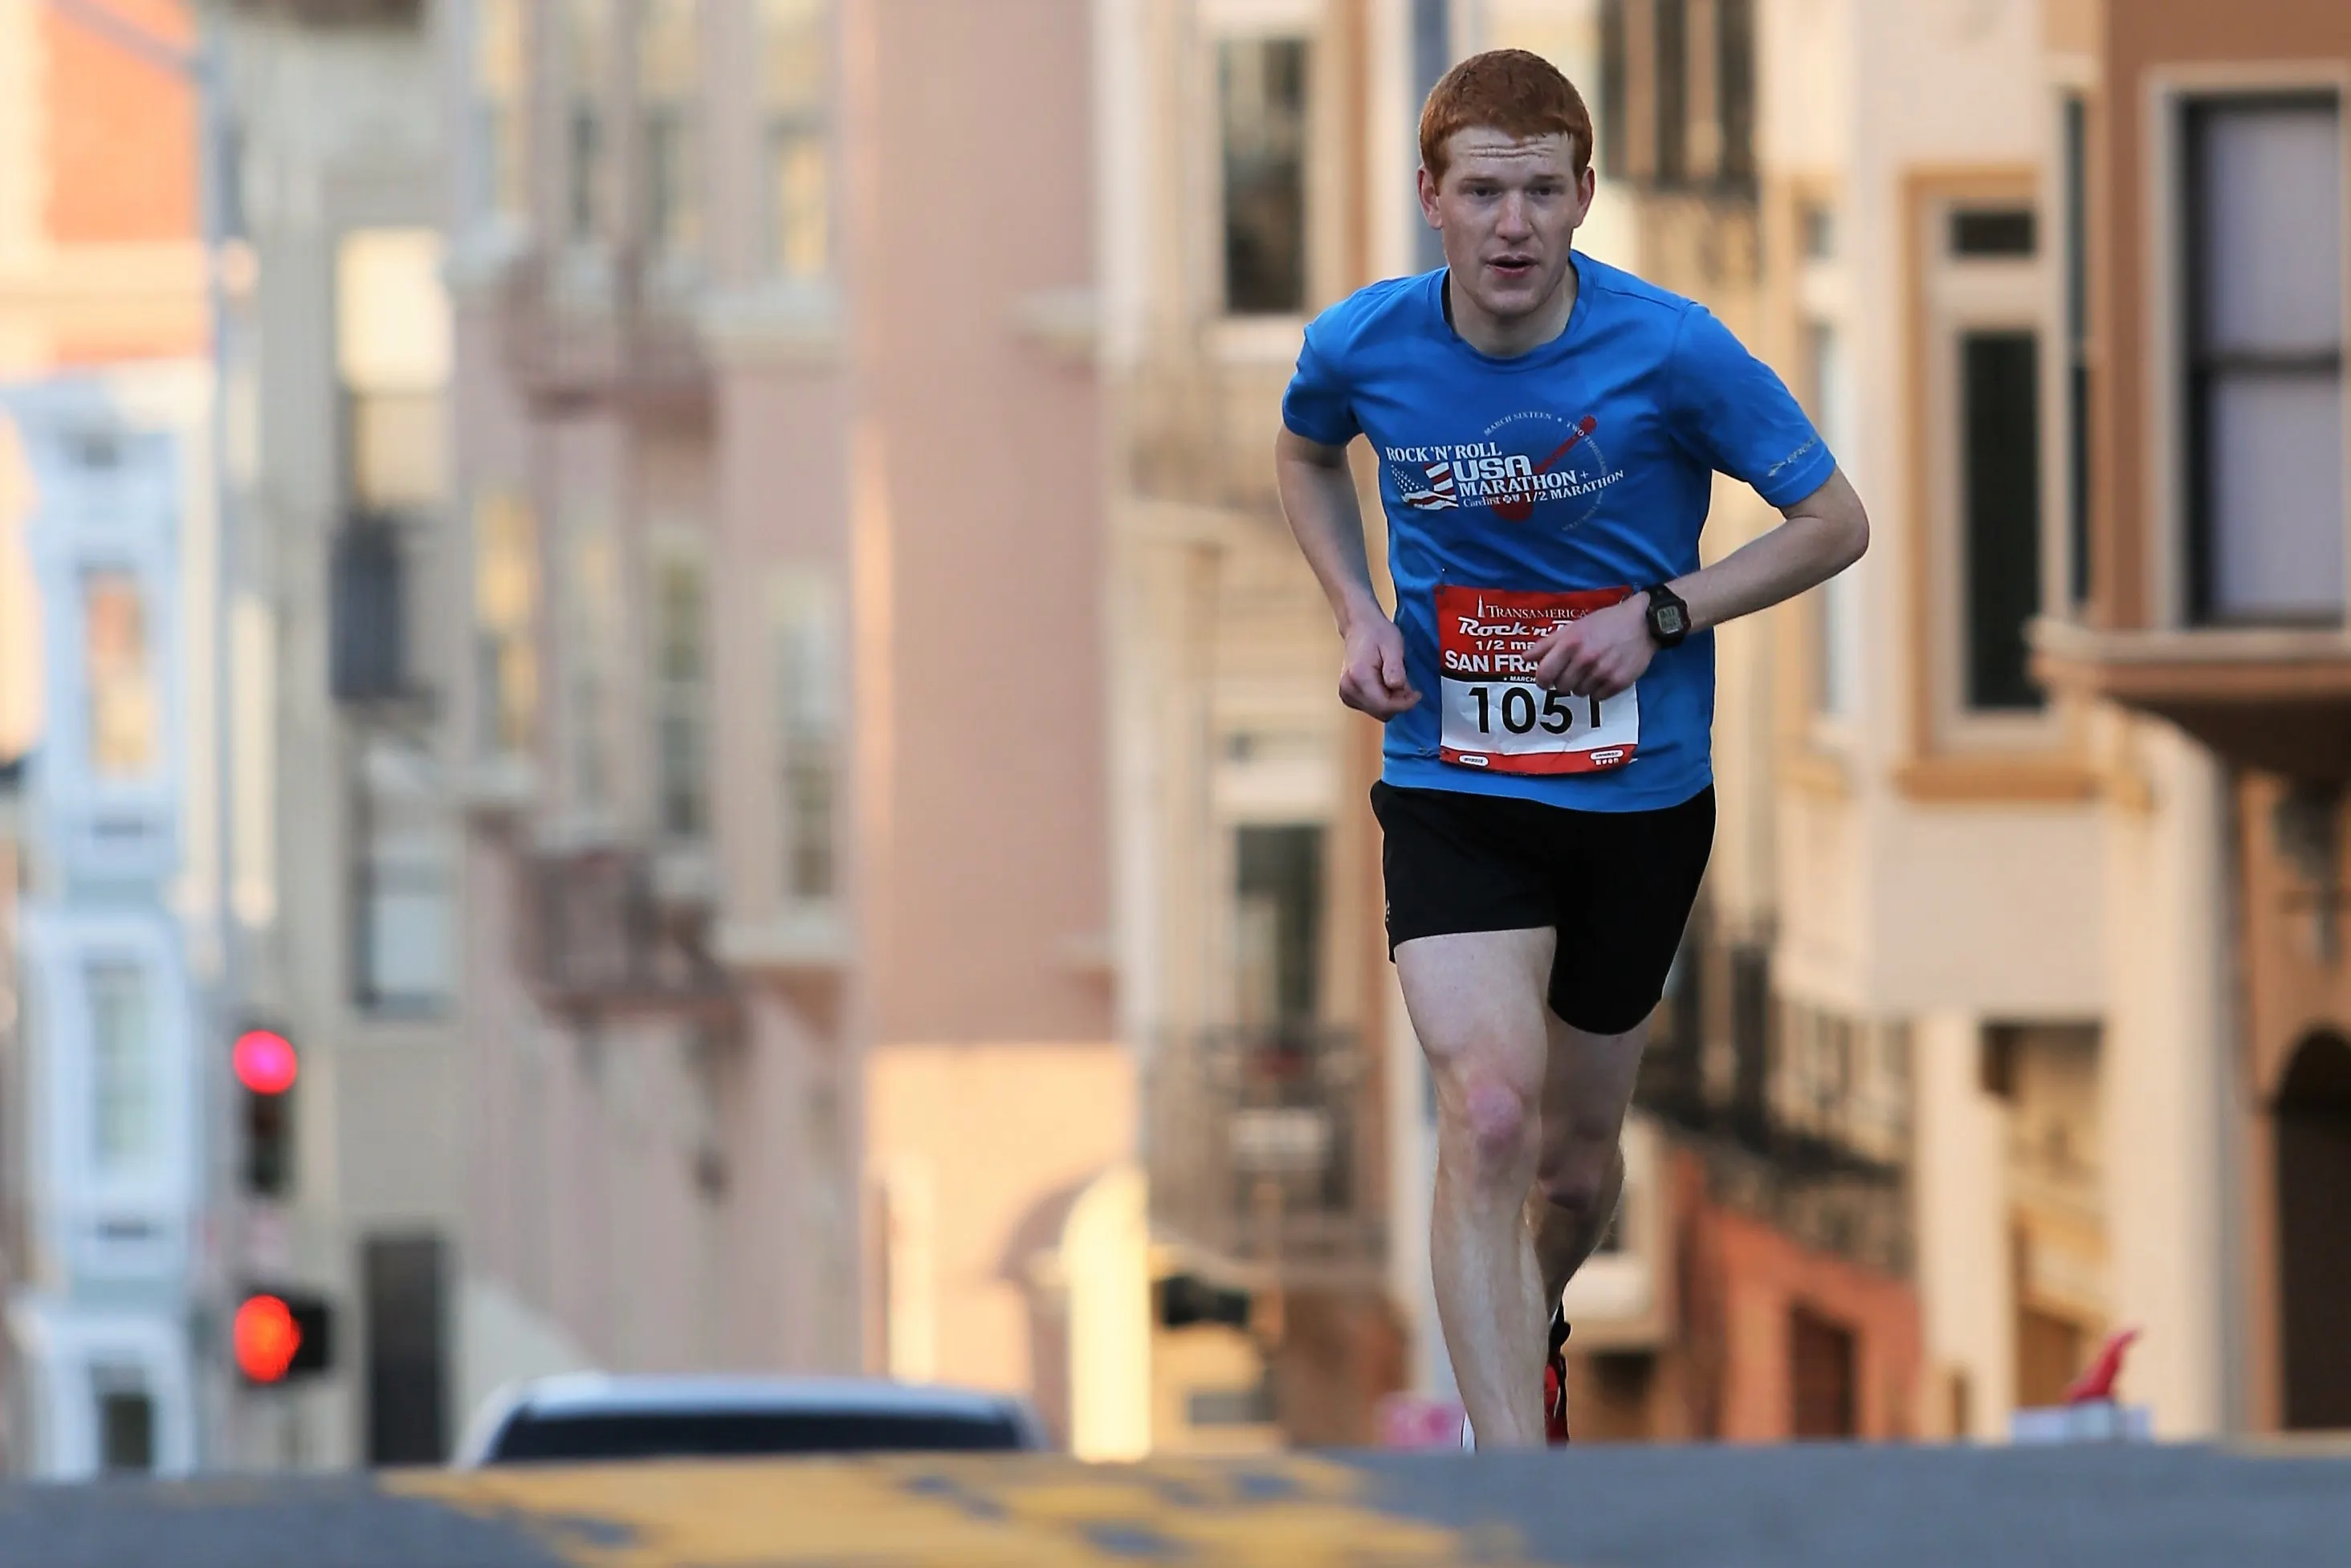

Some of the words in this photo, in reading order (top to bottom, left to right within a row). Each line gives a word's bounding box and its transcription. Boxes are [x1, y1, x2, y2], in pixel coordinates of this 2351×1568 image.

[1385, 446, 1429, 462] ROCK
[1454, 442, 1502, 459] ROLL
[1484, 413, 1512, 436] MARCH
[1513, 410, 1552, 420] SIXTEEN
[1567, 420, 1584, 436] TWO
[1584, 434, 1607, 476] THOUSA
[1453, 454, 1533, 482] USA
[1458, 470, 1578, 497] MARATHON
[1526, 491, 1548, 503] 1/2
[1550, 470, 1624, 500] MARATHON
[1457, 616, 1530, 636] Rock
[1476, 640, 1506, 651] 1/2
[1445, 650, 1489, 673] SAN
[1510, 675, 1536, 683] MARCH
[1469, 686, 1601, 735] 1051
